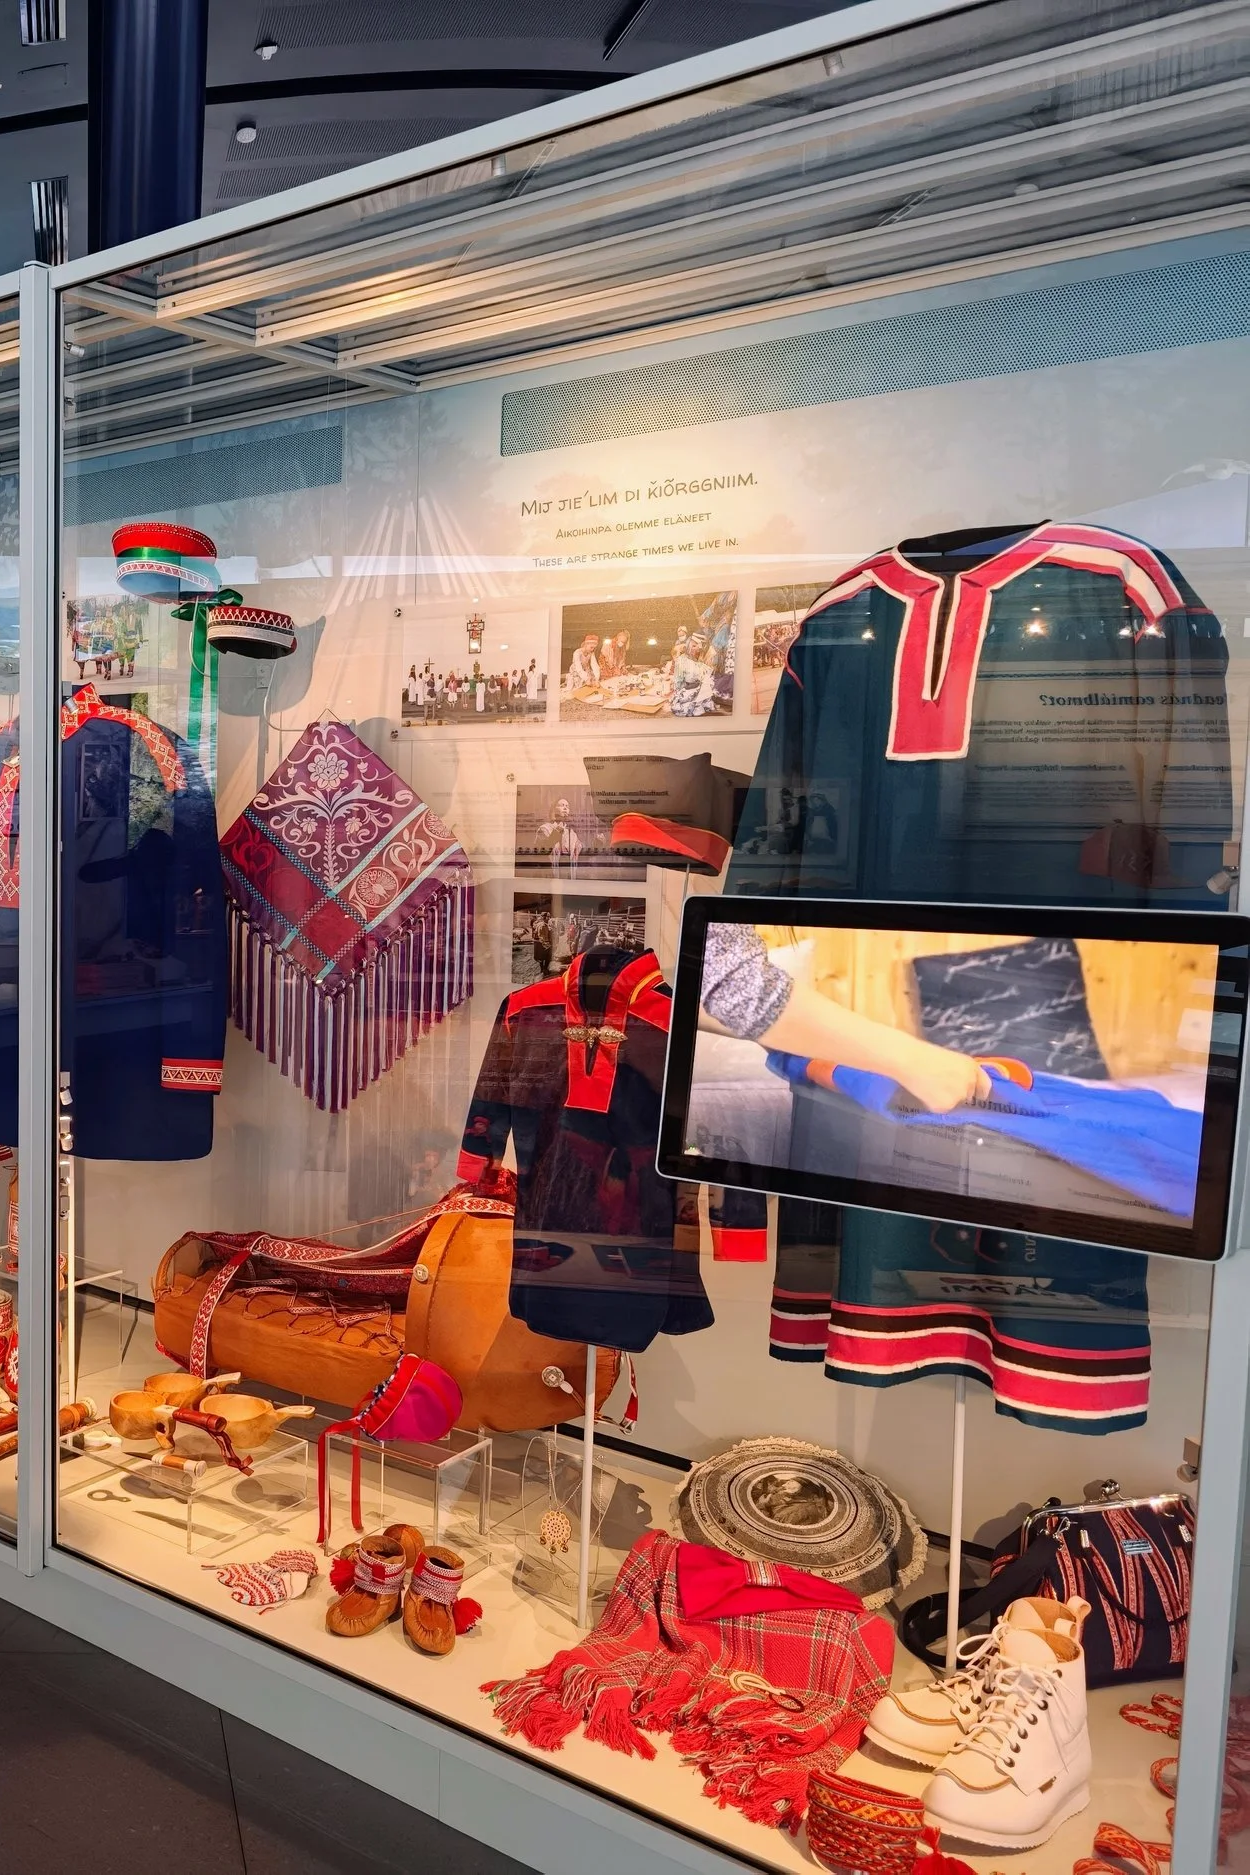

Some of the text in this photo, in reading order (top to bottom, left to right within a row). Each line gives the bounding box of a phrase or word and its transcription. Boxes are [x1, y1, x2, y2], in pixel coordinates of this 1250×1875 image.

[521, 499, 553, 516] MIJ
[625, 488, 640, 503] DI
[555, 511, 712, 540] AIKOIHINPA OLEMME ELÄNEET
[532, 536, 739, 568] THESE ARE STRANGE TIMES WE LIVE IN.
